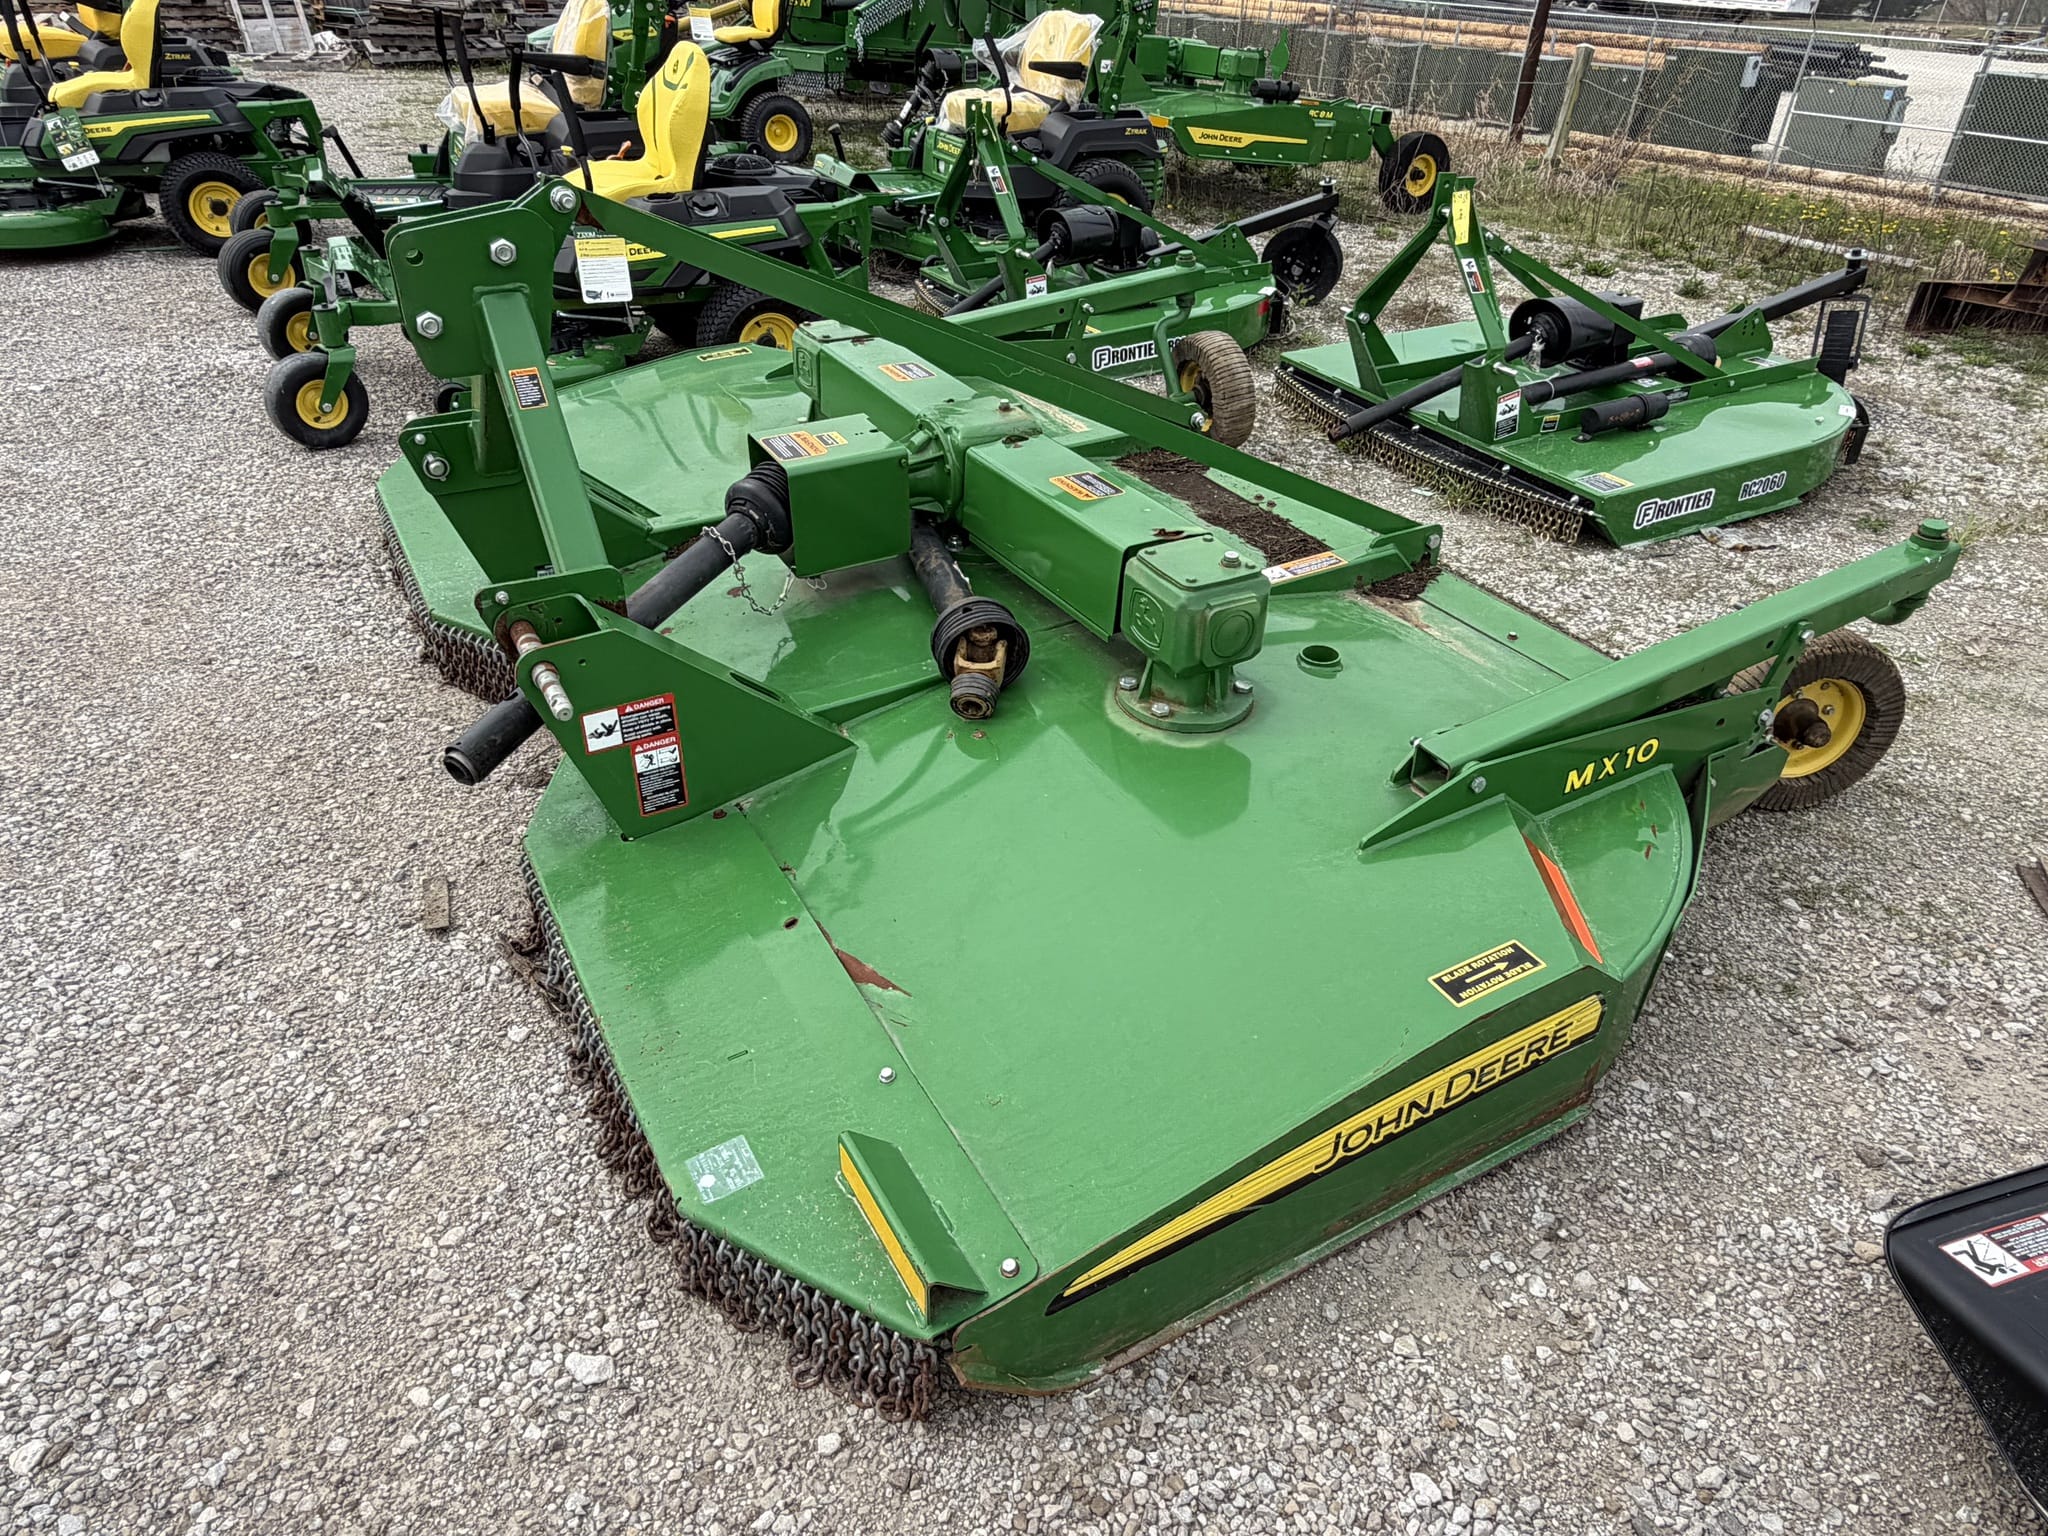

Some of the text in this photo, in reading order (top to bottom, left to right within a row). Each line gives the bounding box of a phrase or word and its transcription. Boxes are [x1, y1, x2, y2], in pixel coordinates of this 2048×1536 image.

[164, 52, 191, 60] ZTRAK
[84, 126, 113, 134] DEERE
[1124, 127, 1148, 135] ZTRAK
[1199, 131, 1243, 143] JOHN DEERE
[1094, 342, 1158, 369] FRONTIE
[1740, 472, 1786, 499] RC2060
[1635, 490, 1714, 527] FRONTIER
[633, 697, 665, 710] DANGER
[643, 736, 676, 750] DANGER
[1440, 946, 1515, 983] BLADE ROTATION
[1458, 961, 1534, 999] BLADE ROTATION
[1313, 1018, 1577, 1172] JOHN DEERE
